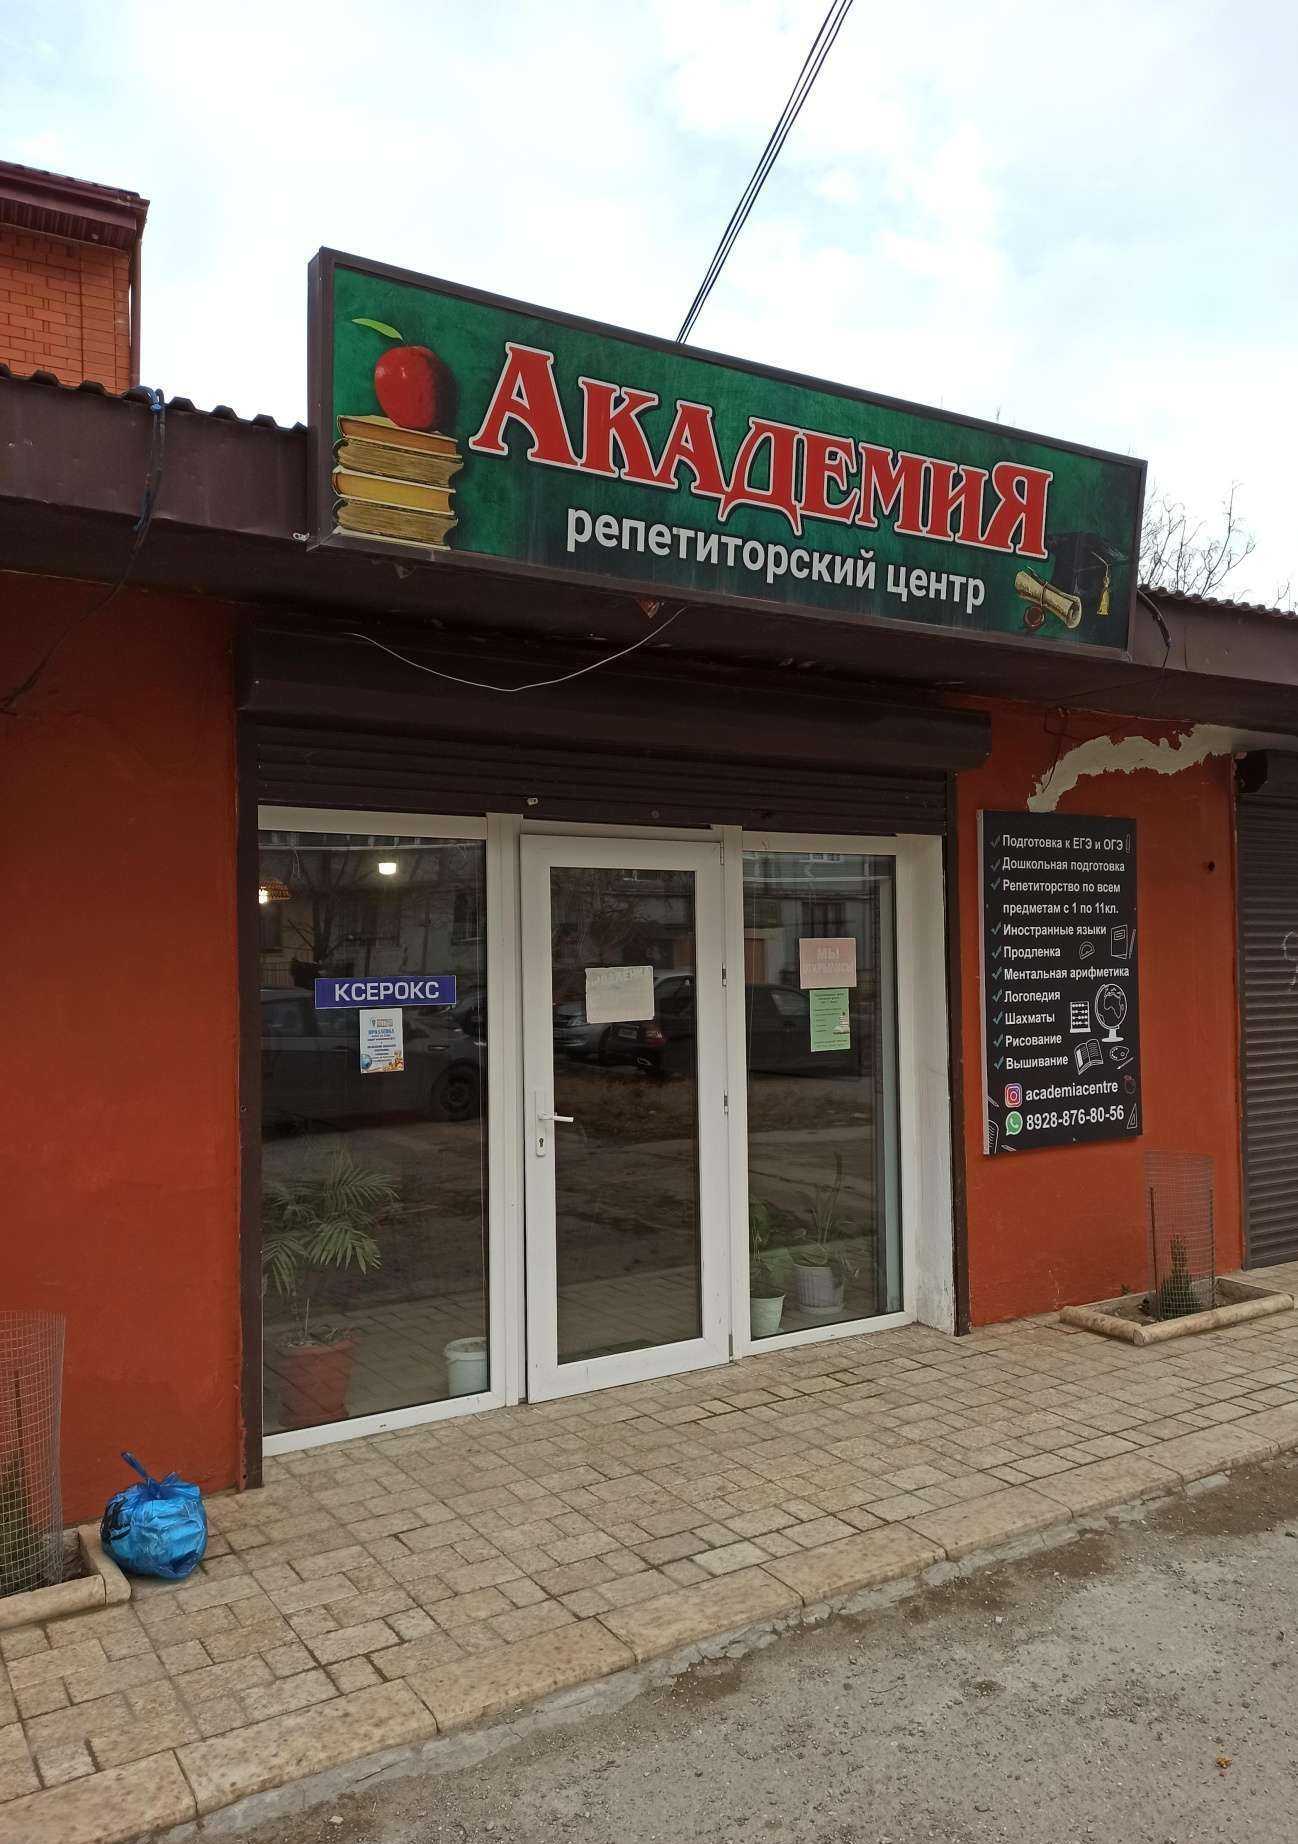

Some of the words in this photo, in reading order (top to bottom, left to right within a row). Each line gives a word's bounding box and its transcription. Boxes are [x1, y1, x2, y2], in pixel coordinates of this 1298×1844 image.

[469, 341, 1054, 560] АКАДЕМИЯ
[566, 507, 876, 590] репетиторский
[887, 564, 985, 614] центр
[1002, 835, 1062, 849] Подготовка
[1065, 840, 1071, 849] к
[1073, 837, 1092, 849] ЕГЭ
[1095, 841, 1101, 850] и
[1103, 838, 1124, 850] ОГЭ
[1002, 857, 1068, 871] Дошкольная
[1070, 861, 1125, 872] подготовка
[1002, 879, 1080, 894] Репетиторство
[1083, 882, 1095, 892] по
[1097, 883, 1121, 893] всем
[1003, 904, 1061, 916] предметам
[1063, 904, 1070, 914] с
[1072, 902, 1077, 914] 1
[1080, 904, 1093, 914] по
[1095, 902, 1119, 914] 11кл.
[1003, 924, 1074, 938] Иностранные
[1076, 926, 1107, 935] языки
[1003, 946, 1061, 960] Продленка
[1004, 968, 1068, 980] Ментальная
[1070, 966, 1130, 980] арифметика
[334, 981, 440, 1002] КСЕРОКС
[1004, 990, 1061, 1003] Логопедия
[1005, 1012, 1055, 1025] Шахматы
[1005, 1034, 1062, 1047] Рисование
[1006, 1056, 1069, 1070] Вышивание
[1025, 1080, 1119, 1101] academiacentre
[1026, 1105, 1125, 1131] 8928-876-80-56
